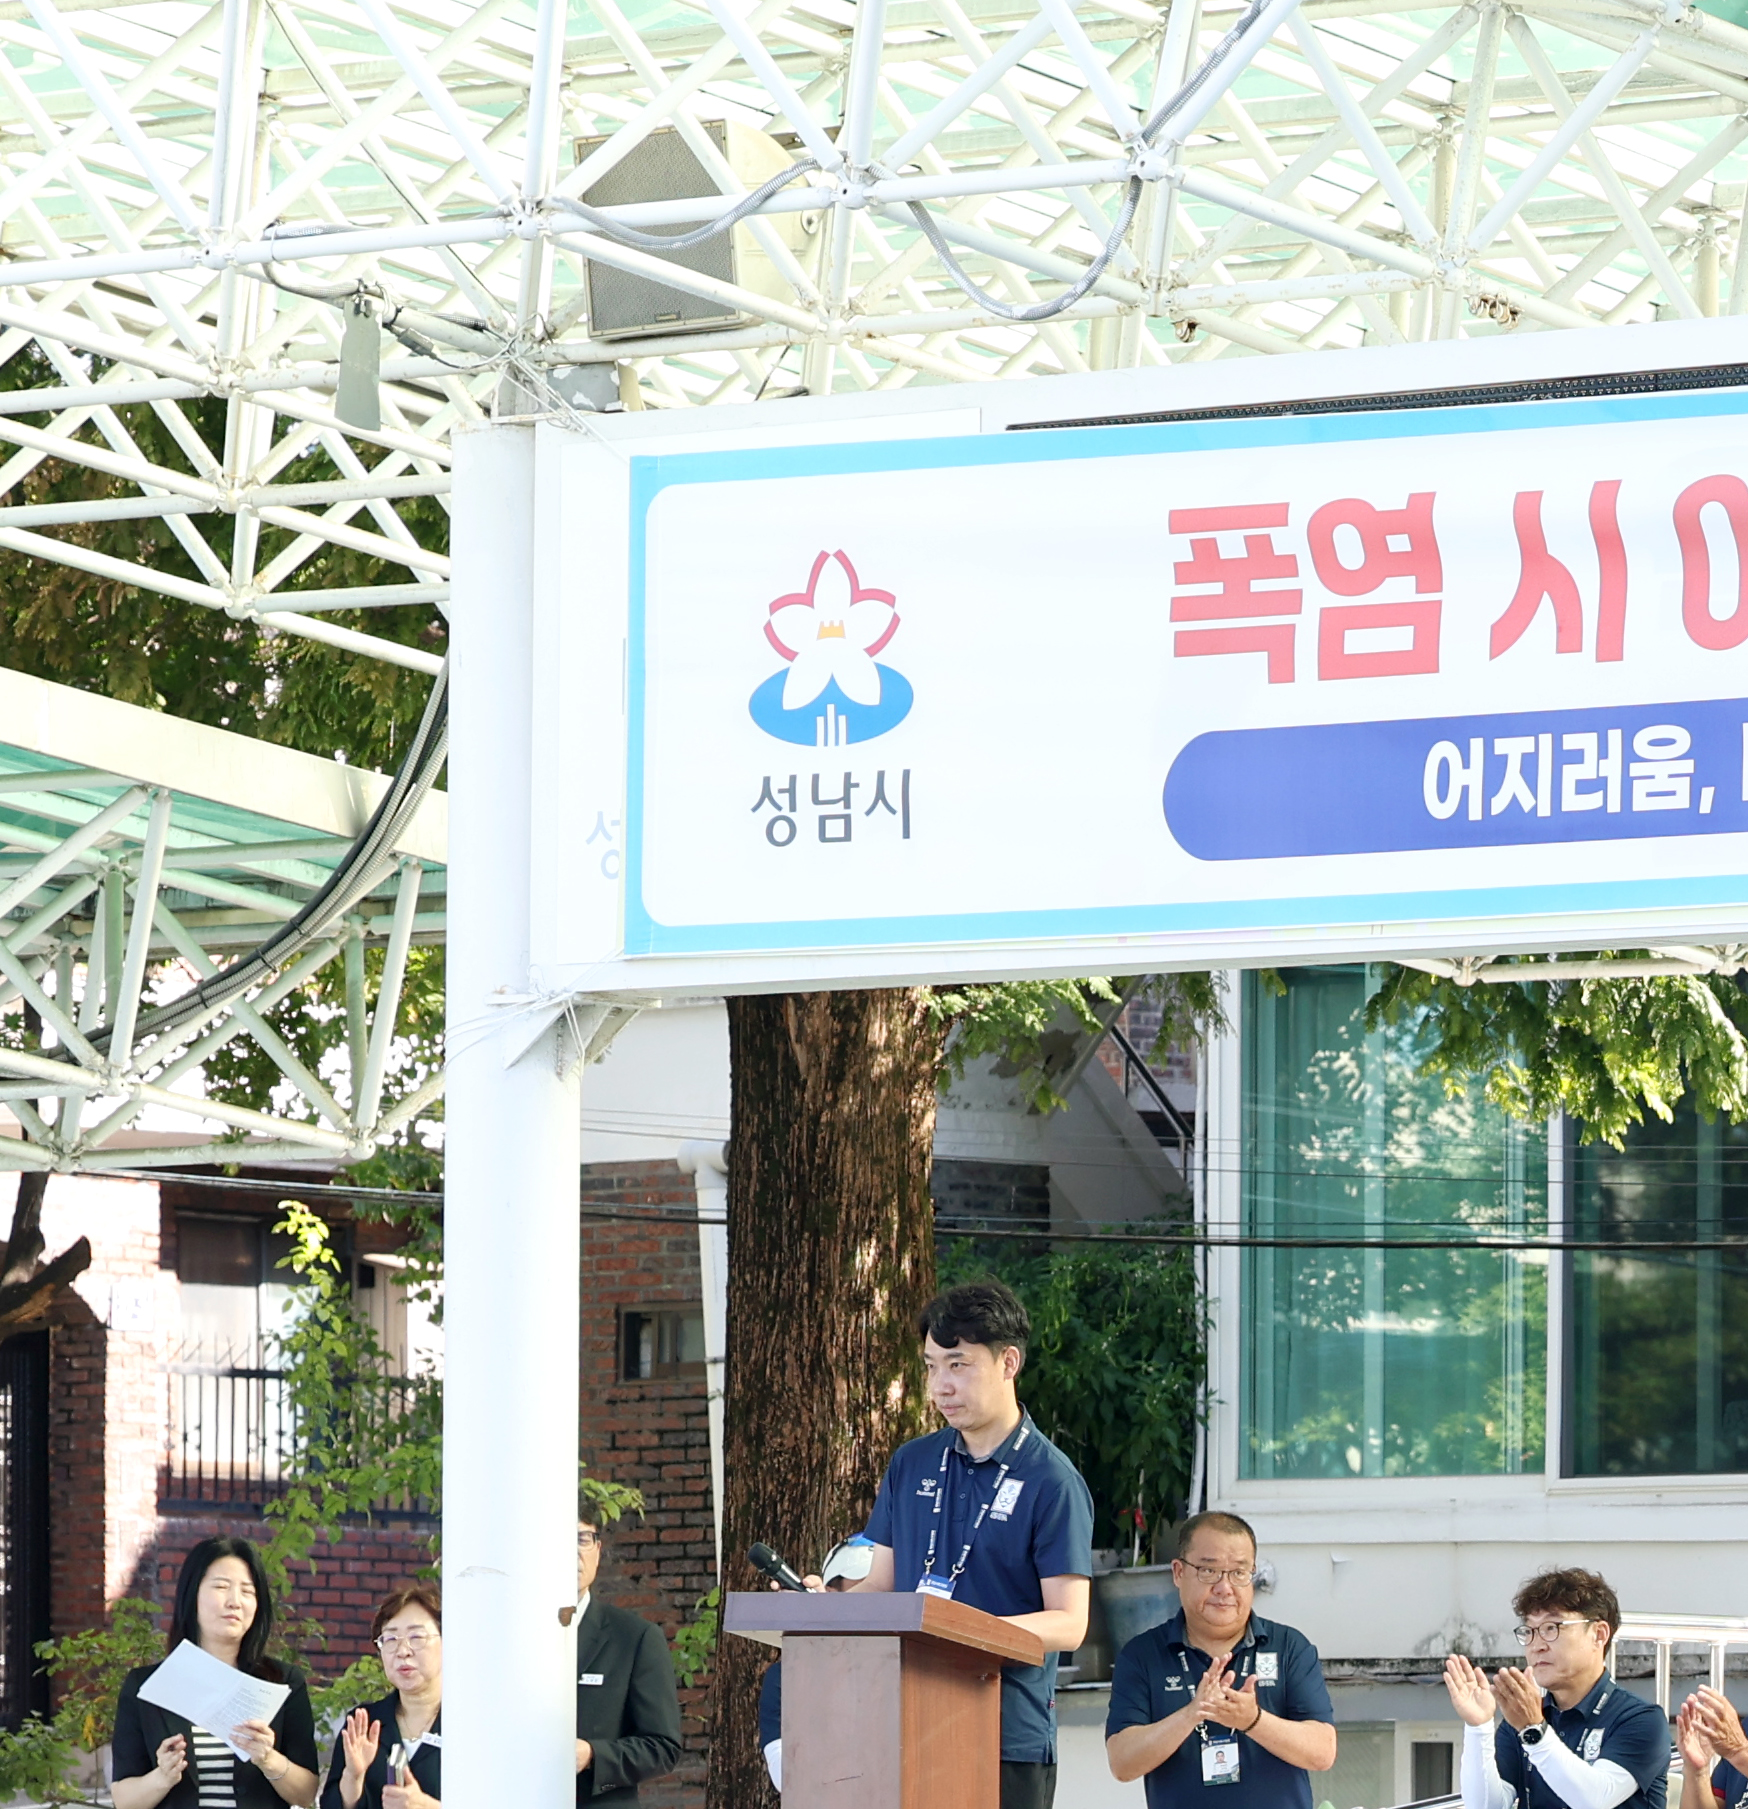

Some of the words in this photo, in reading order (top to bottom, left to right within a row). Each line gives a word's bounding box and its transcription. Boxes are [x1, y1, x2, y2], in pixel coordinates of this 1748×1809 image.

[1167, 491, 1443, 684] 폭염
[1489, 478, 1628, 663] 시
[749, 767, 912, 848] 성남시
[1422, 723, 1716, 822] 어지러움,
